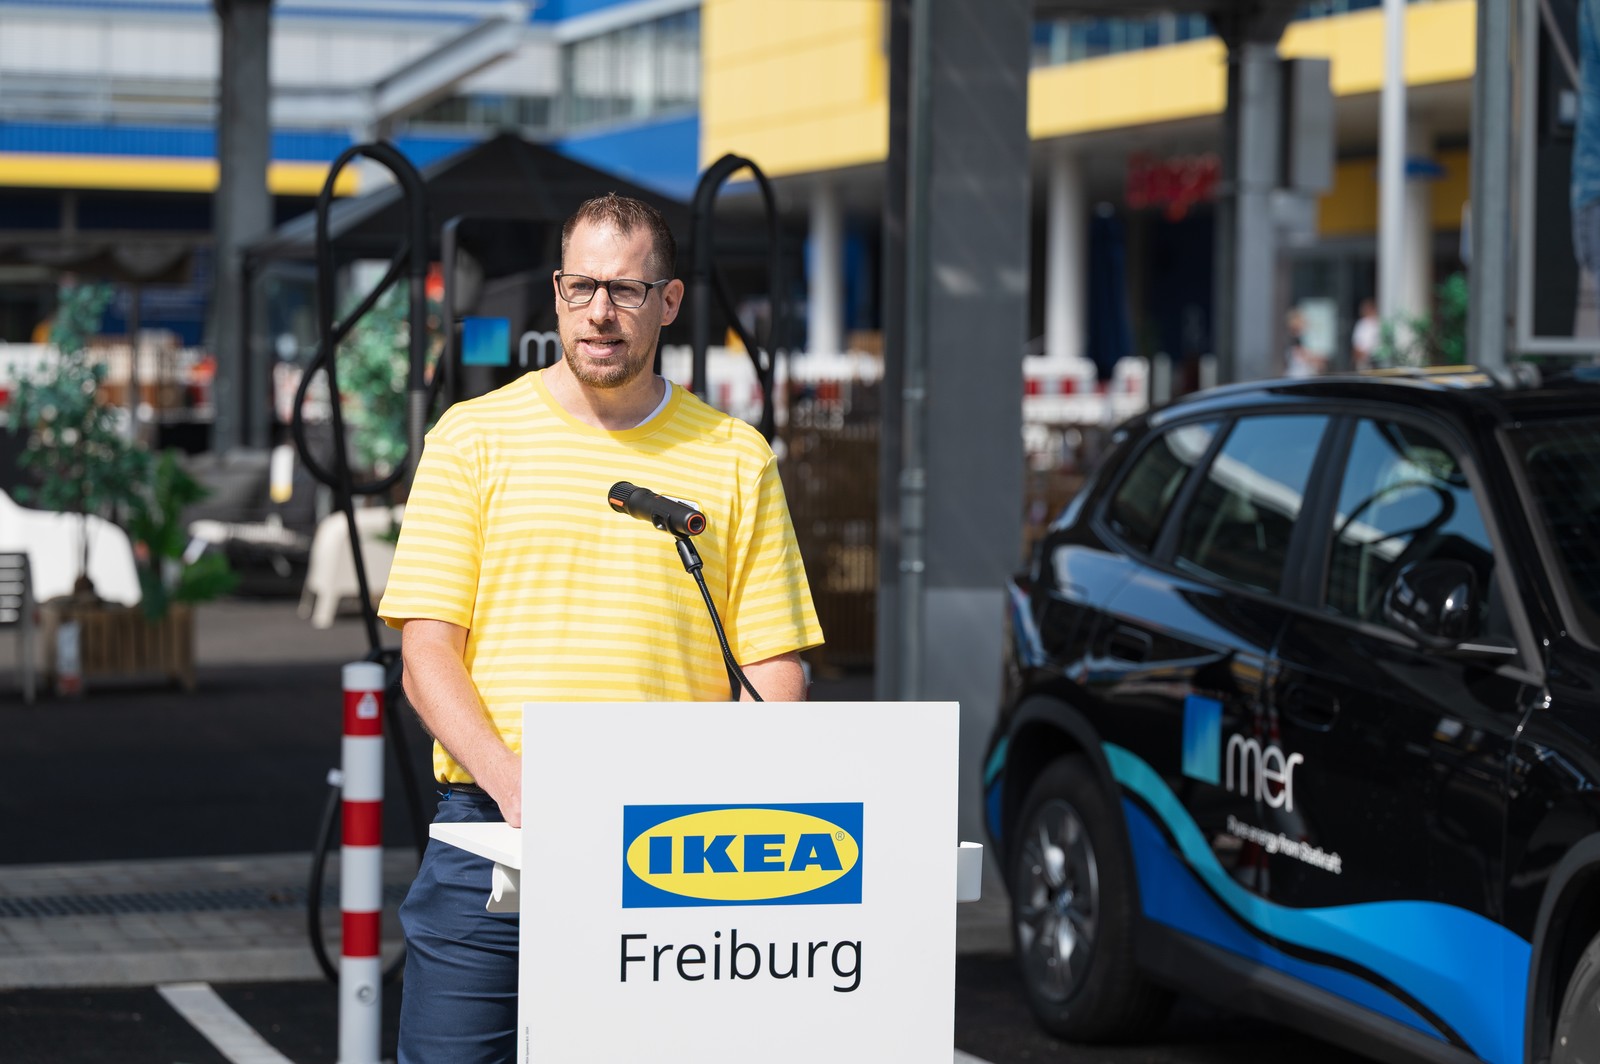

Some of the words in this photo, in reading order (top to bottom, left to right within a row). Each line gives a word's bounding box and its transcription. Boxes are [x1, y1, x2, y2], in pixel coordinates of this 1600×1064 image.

[1226, 733, 1304, 813] mer
[648, 833, 844, 875] IKEA
[620, 928, 862, 992] Freiburg
